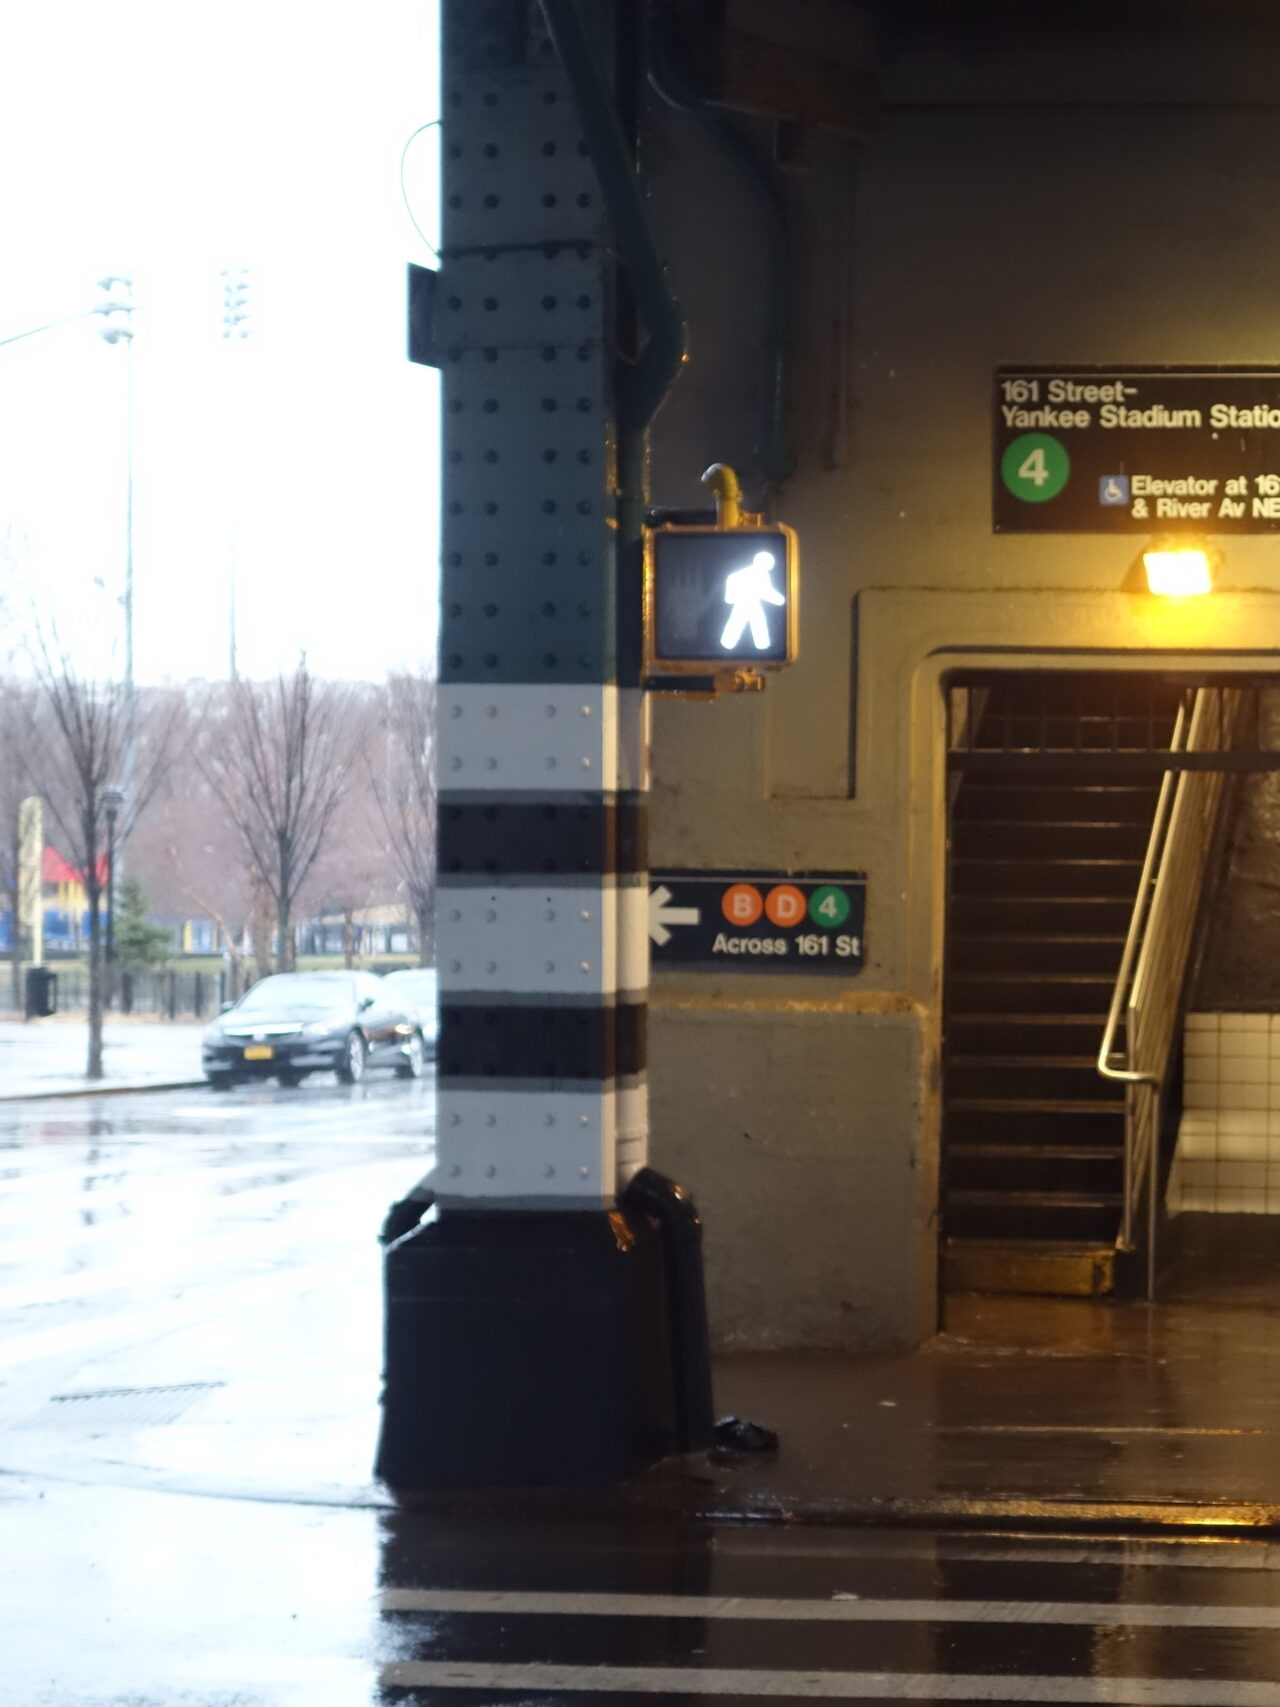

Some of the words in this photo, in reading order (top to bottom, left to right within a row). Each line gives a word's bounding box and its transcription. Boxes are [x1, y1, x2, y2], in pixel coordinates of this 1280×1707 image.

[1001, 380, 1039, 402] 161
[1001, 405, 1091, 427] Yankee
[1099, 404, 1201, 427] Stadium
[1017, 448, 1049, 486] 4
[1131, 475, 1218, 496] Elevator
[1225, 476, 1248, 495] at
[1131, 499, 1148, 518] &
[1156, 498, 1212, 518] River
[1218, 499, 1246, 518] Av
[733, 893, 754, 918] B
[776, 894, 797, 918] D
[817, 895, 838, 918] 4
[711, 933, 787, 955] Across
[795, 934, 828, 956] 161
[835, 935, 860, 956] St
